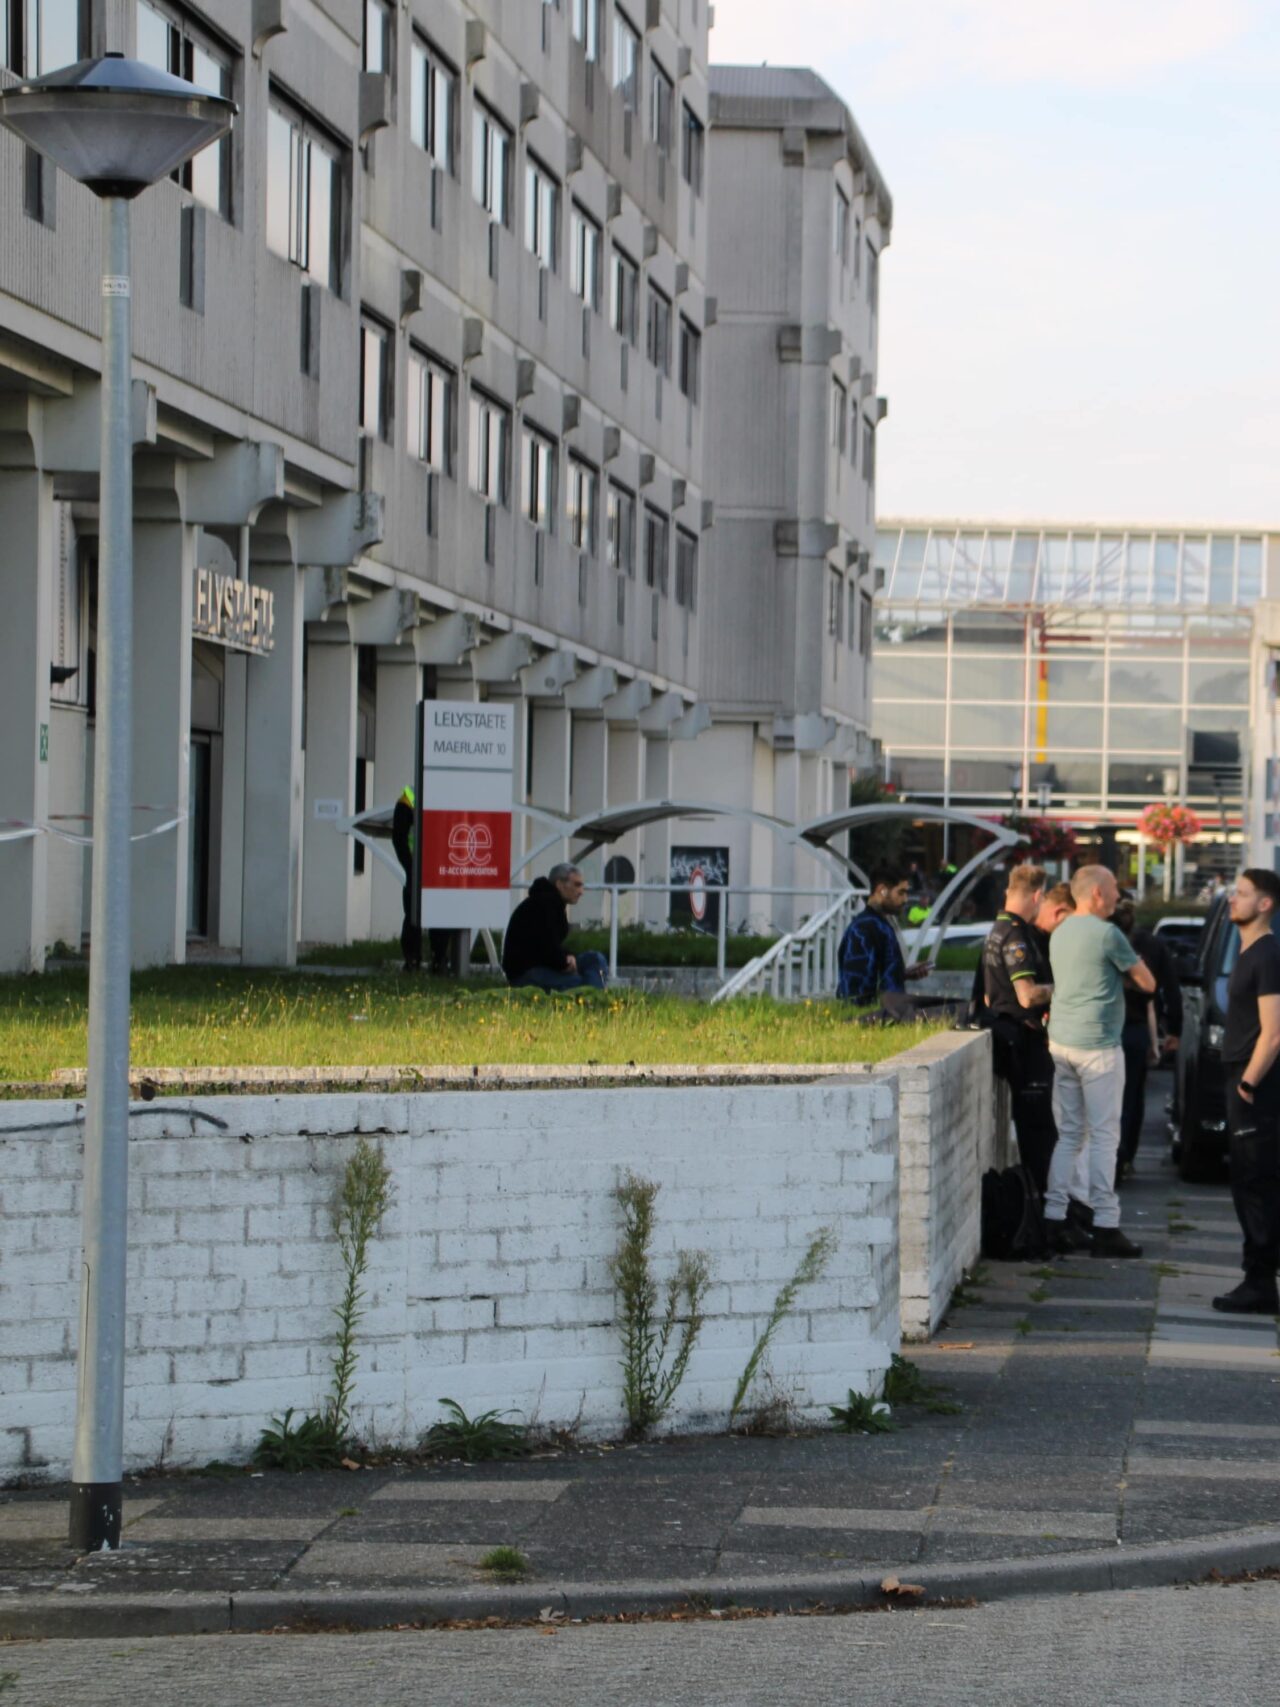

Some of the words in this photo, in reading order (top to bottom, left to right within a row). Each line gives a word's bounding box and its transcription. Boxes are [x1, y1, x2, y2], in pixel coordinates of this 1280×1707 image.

[434, 711, 507, 730] LELYSTAETE
[433, 740, 494, 756] MAERLANT
[496, 743, 507, 756] 10
